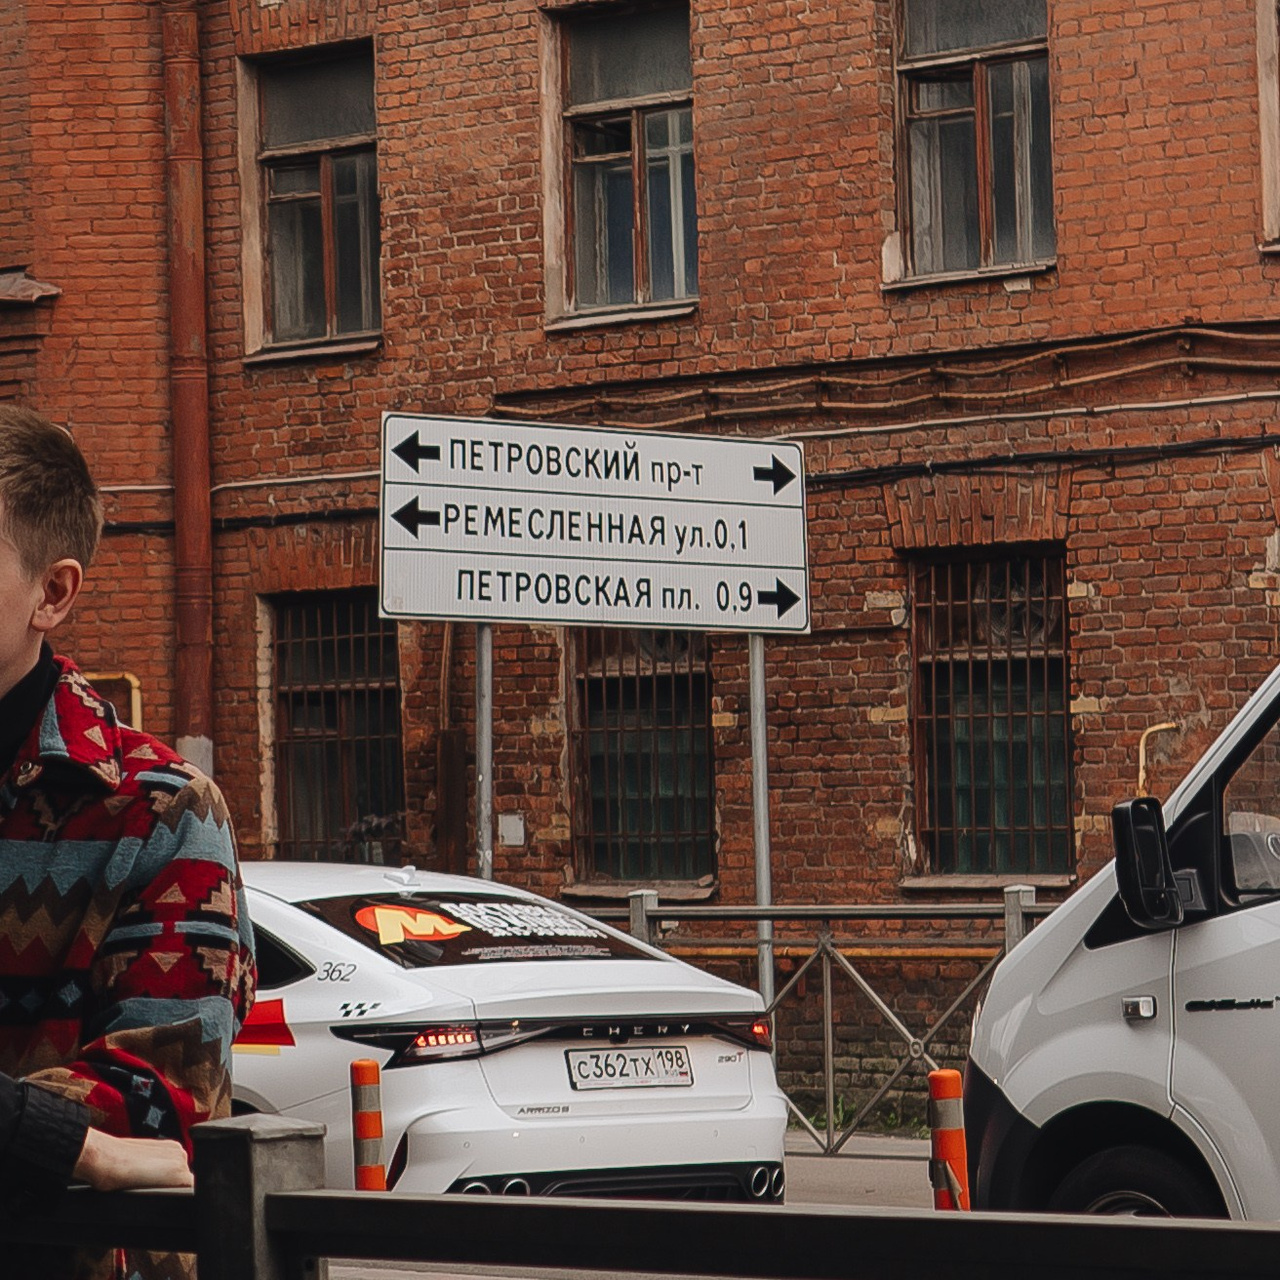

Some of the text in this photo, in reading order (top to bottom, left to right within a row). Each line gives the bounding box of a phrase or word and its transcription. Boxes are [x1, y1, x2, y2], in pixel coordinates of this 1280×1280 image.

[450, 438, 703, 492] ПЕТРОВСКИЙ пр-т
[444, 503, 666, 546] РЕМЕСЛЕННАЯ
[457, 569, 752, 615] ПЕТРОВСКАЯ пл. 0,9
[317, 961, 357, 982] 362
[582, 1023, 690, 1037] CHERY
